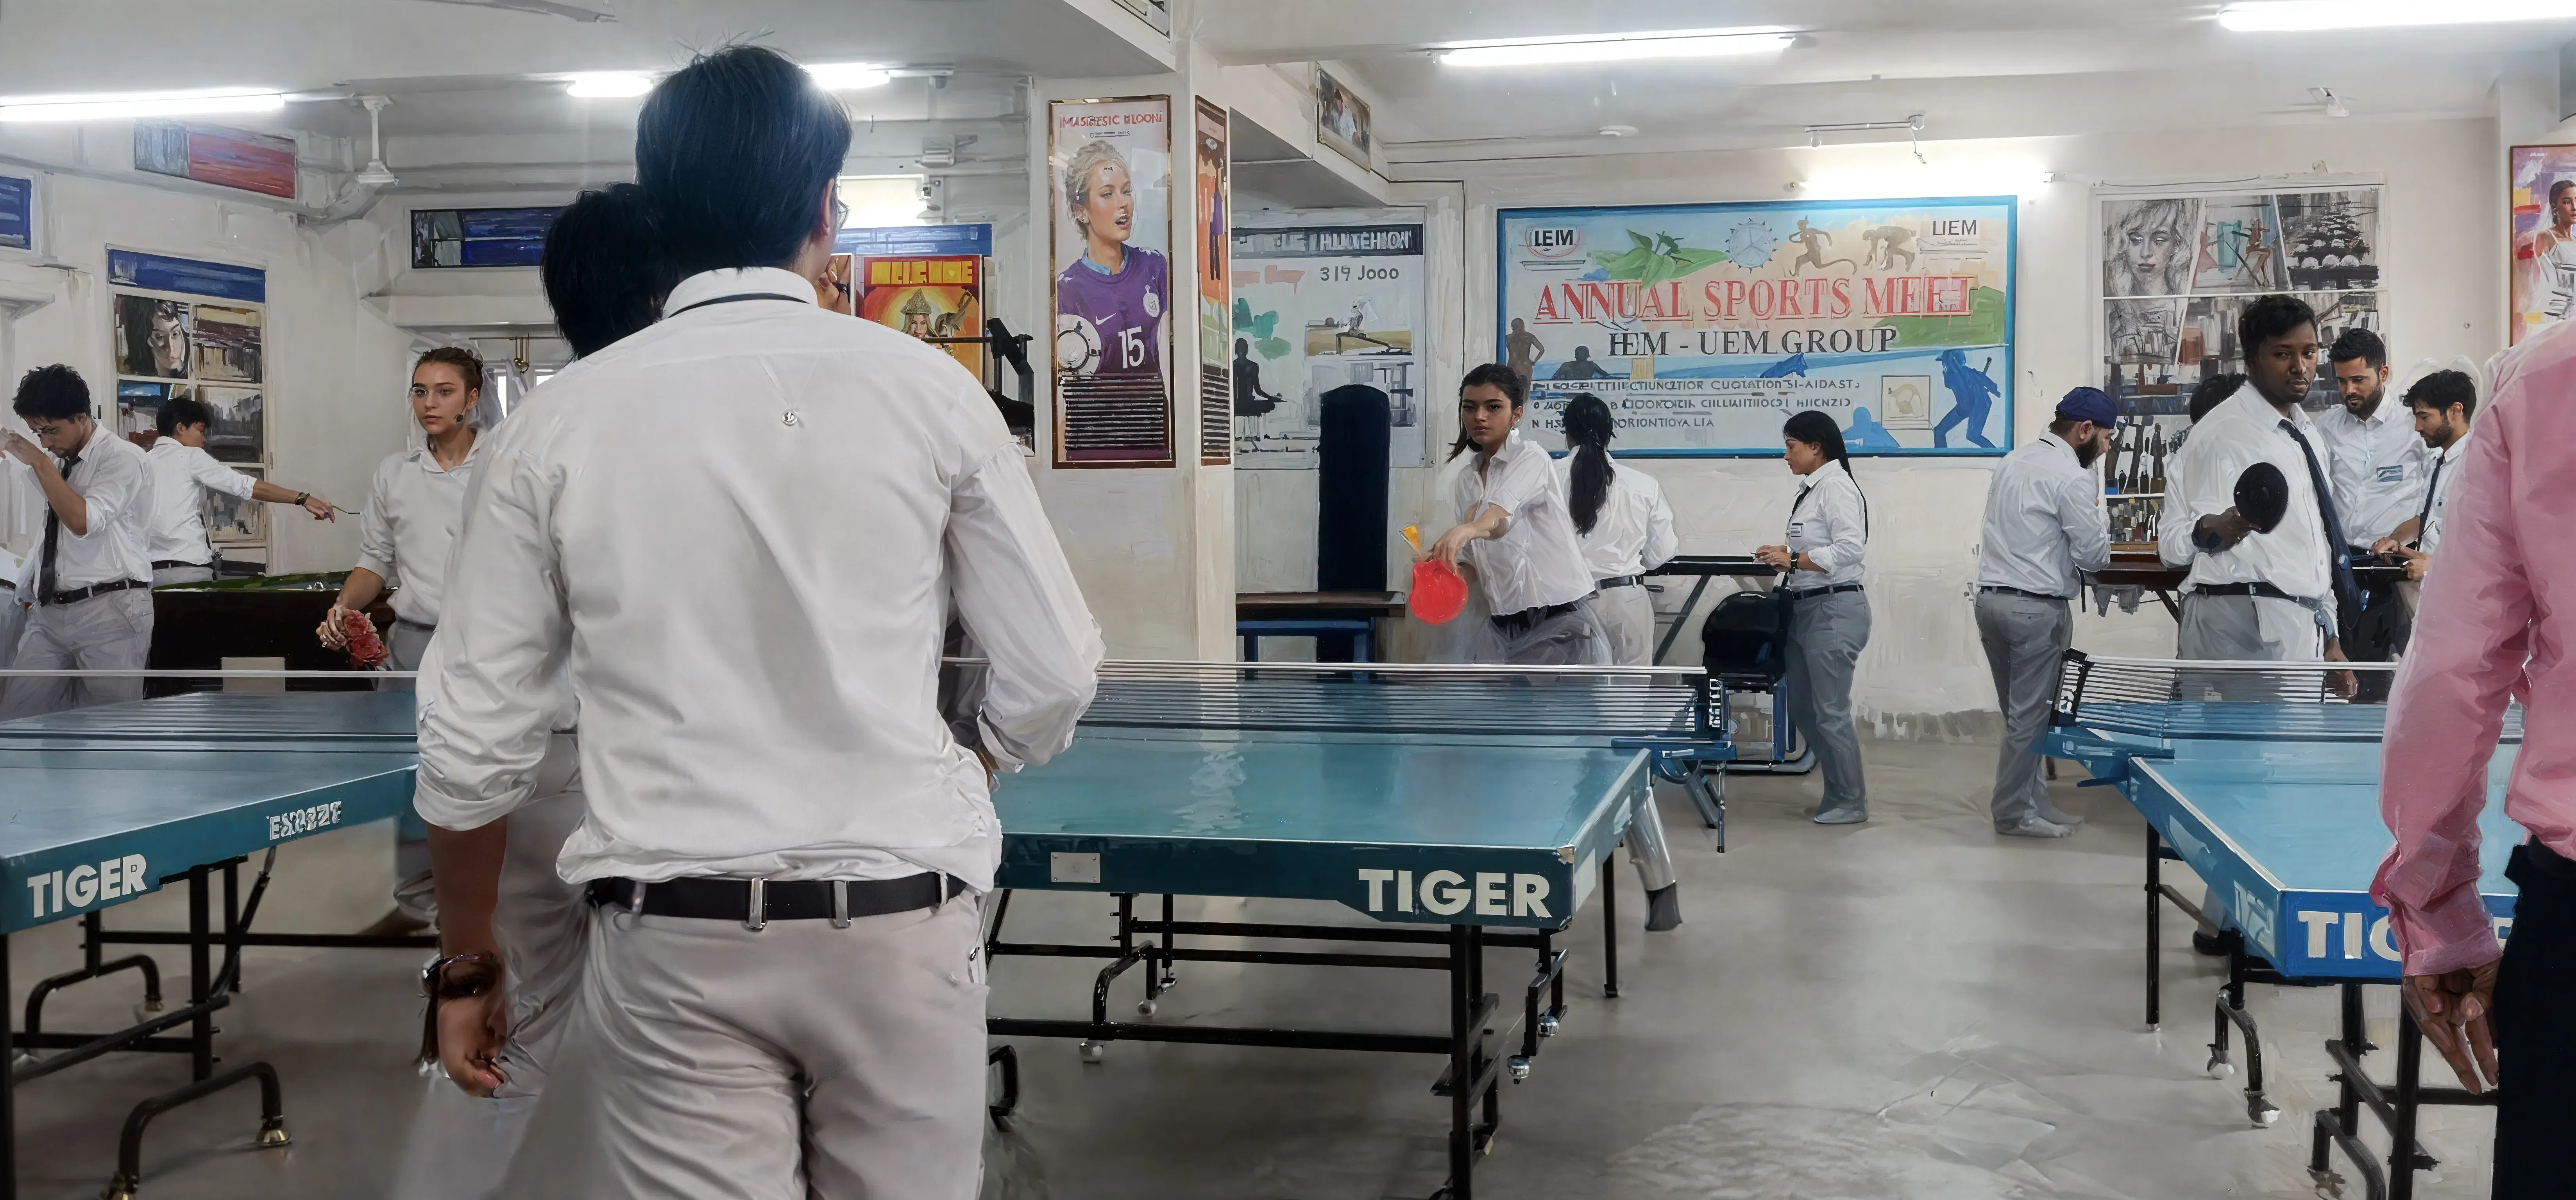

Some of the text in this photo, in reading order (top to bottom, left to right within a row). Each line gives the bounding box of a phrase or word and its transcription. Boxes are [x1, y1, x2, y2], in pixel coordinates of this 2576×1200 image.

[1535, 281, 1690, 321] ANNUAL
[1704, 278, 1851, 317] SPORTS
[1118, 326, 1145, 369] 15
[1698, 330, 1778, 355] UEM
[1781, 329, 1896, 354] GROUP
[27, 854, 148, 918] TIGER
[1358, 869, 1553, 918] TIGER
